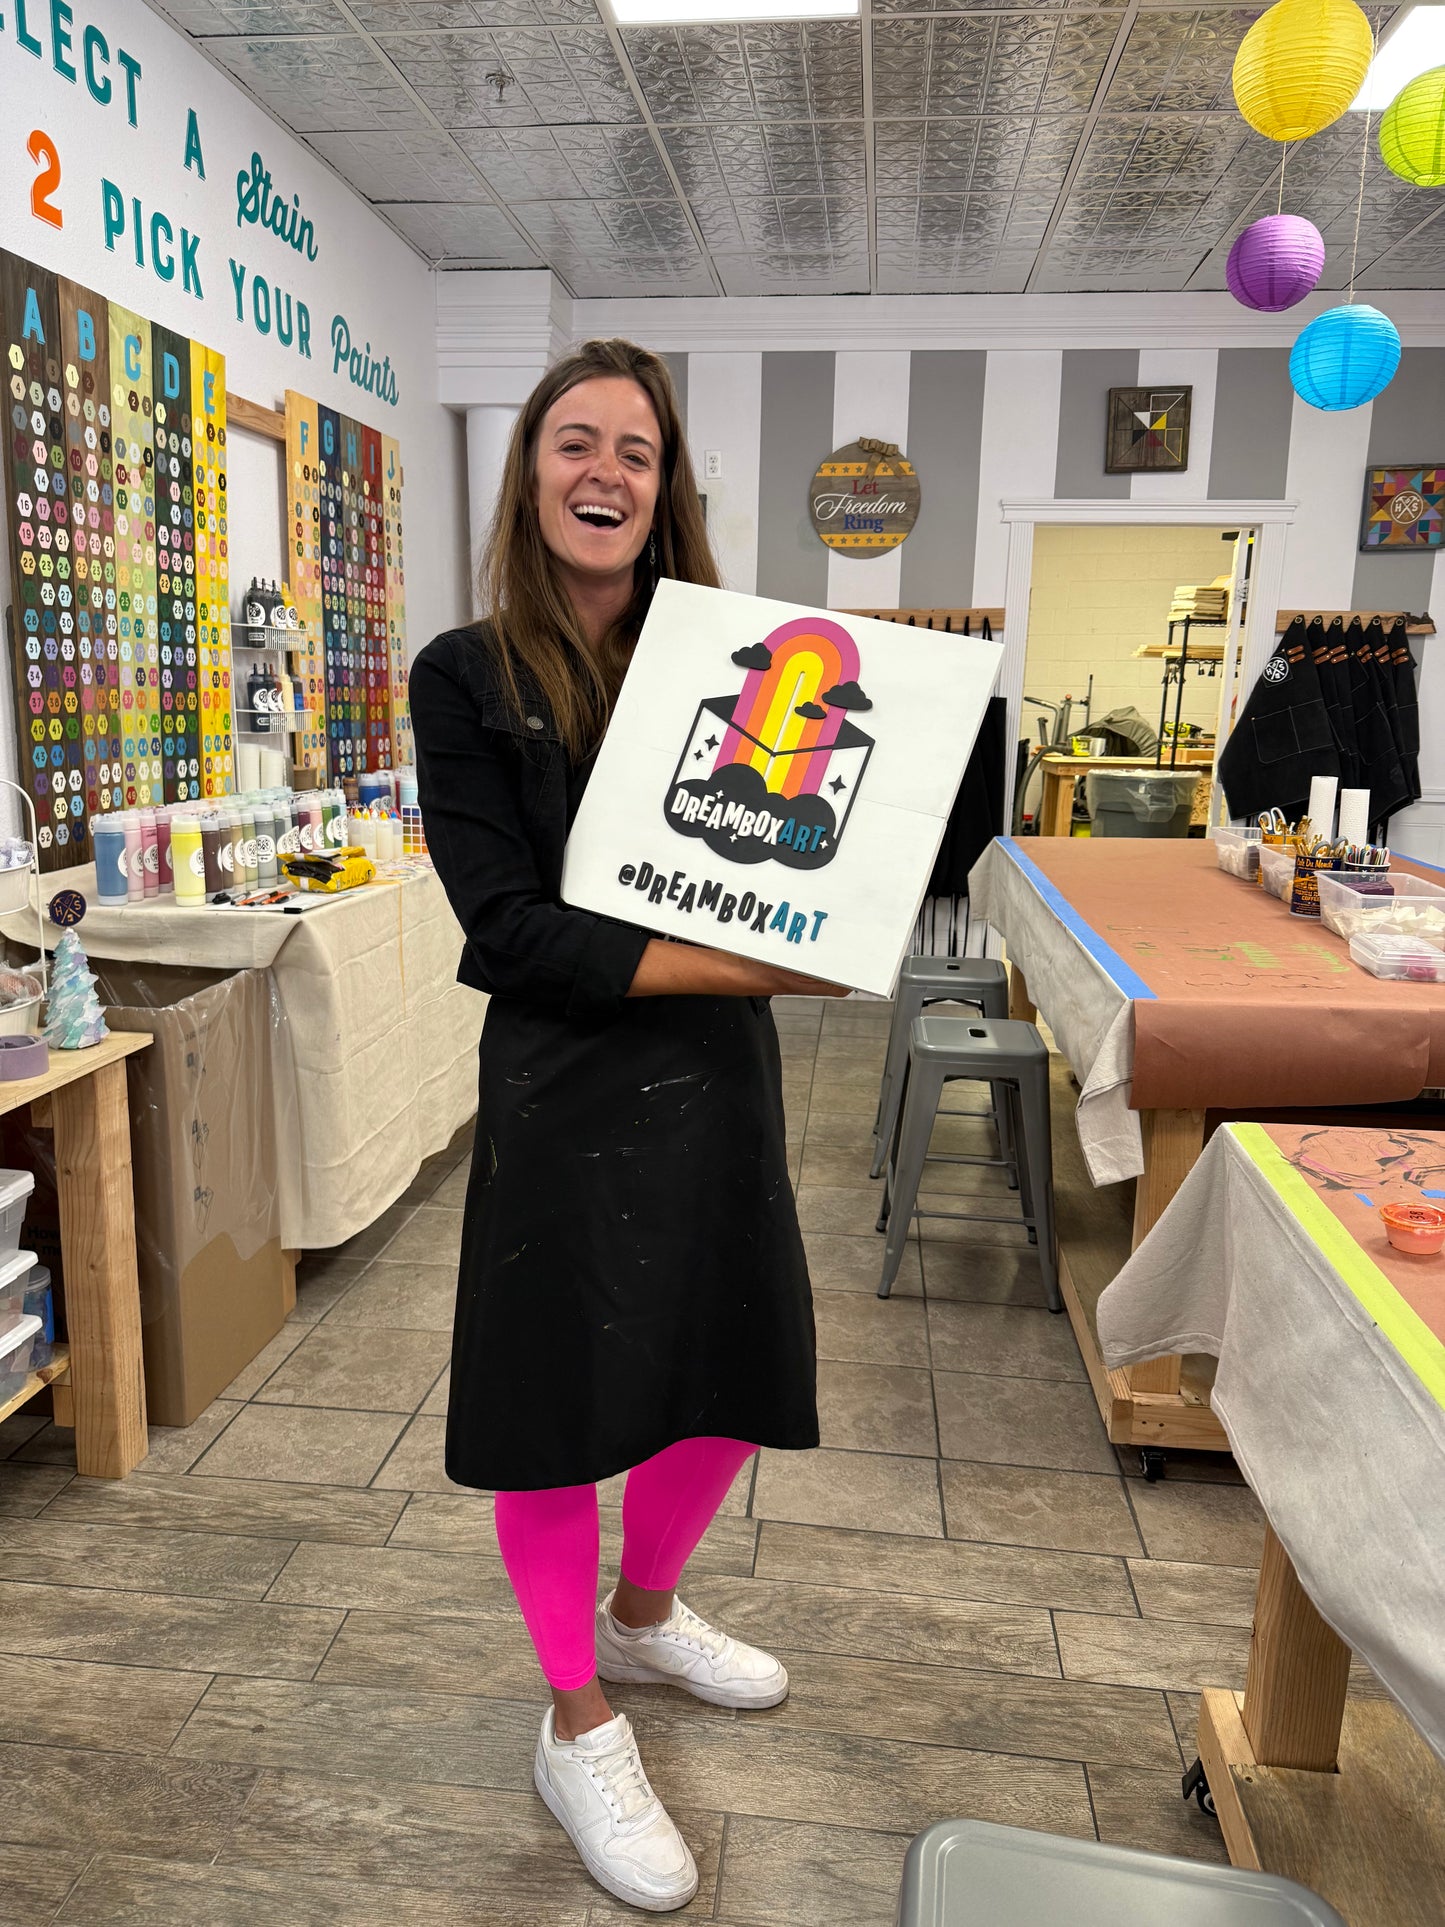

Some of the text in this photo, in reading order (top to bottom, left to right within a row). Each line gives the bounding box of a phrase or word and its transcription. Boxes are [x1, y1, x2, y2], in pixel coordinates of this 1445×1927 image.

[0, 0, 318, 262] LECT A Stain
[27, 129, 400, 406] 2 PICK YOUR Paints
[21, 287, 46, 345] A
[77, 309, 96, 362] B
[15, 352, 18, 363] 1
[124, 334, 141, 381] C
[71, 371, 74, 381] 1
[163, 352, 180, 398] D
[16, 383, 21, 393] 4
[203, 370, 215, 414] E
[34, 390, 39, 400] 5
[52, 396, 57, 406] 6
[72, 400, 76, 409] 4
[132, 398, 136, 407] 2
[88, 406, 91, 416] 5
[145, 402, 149, 411] 3
[103, 412, 106, 421] 6
[36, 418, 41, 428] 8
[89, 433, 93, 442] 8
[300, 421, 308, 456] F
[323, 420, 333, 455] G
[173, 438, 176, 448] 5
[37, 447, 44, 458] 11
[119, 444, 122, 453] 7
[347, 432, 357, 466] H
[54, 451, 61, 463] 12
[72, 455, 80, 466] 10
[147, 453, 150, 461] 9
[370, 444, 375, 475] I
[89, 459, 96, 470] 11
[387, 450, 395, 480] J
[117, 468, 125, 479] 10
[38, 475, 45, 486] 14
[74, 481, 81, 492] 13
[90, 485, 96, 496] 14
[173, 486, 178, 496] 11
[852, 480, 880, 495] Let
[20, 499, 30, 510] 16
[119, 494, 125, 505] 13
[39, 504, 47, 514] 17
[146, 502, 152, 511] 15
[814, 492, 908, 520] Freedom
[1395, 503, 1418, 512] H S
[56, 507, 64, 517] 18
[75, 506, 83, 517] 16
[173, 511, 179, 520] 14
[91, 512, 97, 522] 17
[844, 514, 884, 533] Ring
[22, 528, 31, 539] 19
[40, 532, 49, 541] 20
[161, 530, 167, 540] 16
[58, 535, 66, 545] 21
[91, 539, 99, 549] 20
[174, 534, 179, 544] 17
[106, 540, 113, 550] 21
[23, 557, 34, 569] 22
[161, 555, 167, 564] 19
[173, 558, 181, 567] 20
[186, 560, 192, 569] 21
[41, 560, 51, 571] 23
[59, 563, 68, 573] 24
[77, 562, 86, 573] 22
[92, 565, 100, 576] 23
[106, 568, 114, 578] 24
[161, 579, 168, 587] 22
[174, 582, 181, 590] 23
[186, 584, 193, 593] 24
[43, 589, 53, 599] 26
[61, 592, 69, 602] 27
[107, 595, 114, 604] 27
[121, 597, 129, 607] 25
[187, 607, 193, 616] 27
[26, 615, 37, 626] 28
[62, 618, 71, 628] 30
[108, 618, 115, 627] 30
[121, 622, 130, 631] 28
[135, 624, 143, 633] 29
[29, 641, 38, 653] 31
[46, 644, 56, 655] 32
[64, 645, 73, 655] 33
[82, 643, 89, 653] 31
[163, 651, 170, 660] 31
[188, 652, 195, 661] 33
[30, 671, 40, 681] 34
[66, 671, 74, 682] 36
[83, 669, 91, 679] 34
[137, 671, 145, 681] 35
[163, 674, 171, 684] 34
[32, 697, 41, 708] 37
[66, 697, 76, 707] 39
[100, 720, 107, 729] 41
[164, 719, 173, 728] 40
[177, 720, 185, 728] 41
[33, 726, 44, 735] 40
[52, 725, 61, 735] 41
[139, 741, 147, 751] 44
[152, 741, 160, 751] 45
[35, 752, 45, 762] 43
[53, 751, 62, 761] 44
[126, 767, 135, 776] 46
[179, 764, 186, 773] 47
[190, 763, 198, 771] 48
[102, 770, 108, 779] 47
[113, 768, 120, 777] 48
[55, 778, 63, 787] 47
[71, 775, 80, 785] 48
[179, 786, 187, 795] 50
[191, 784, 198, 793] 51
[103, 794, 110, 803] 50
[114, 792, 121, 801] 51
[56, 804, 66, 813] 50
[73, 801, 82, 810] 51
[670, 787, 827, 853] DREAMBOXART
[40, 833, 50, 843] 52
[58, 829, 67, 839] 53
[618, 861, 829, 944] @DREAMBOXART
[55, 900, 81, 917] H S
